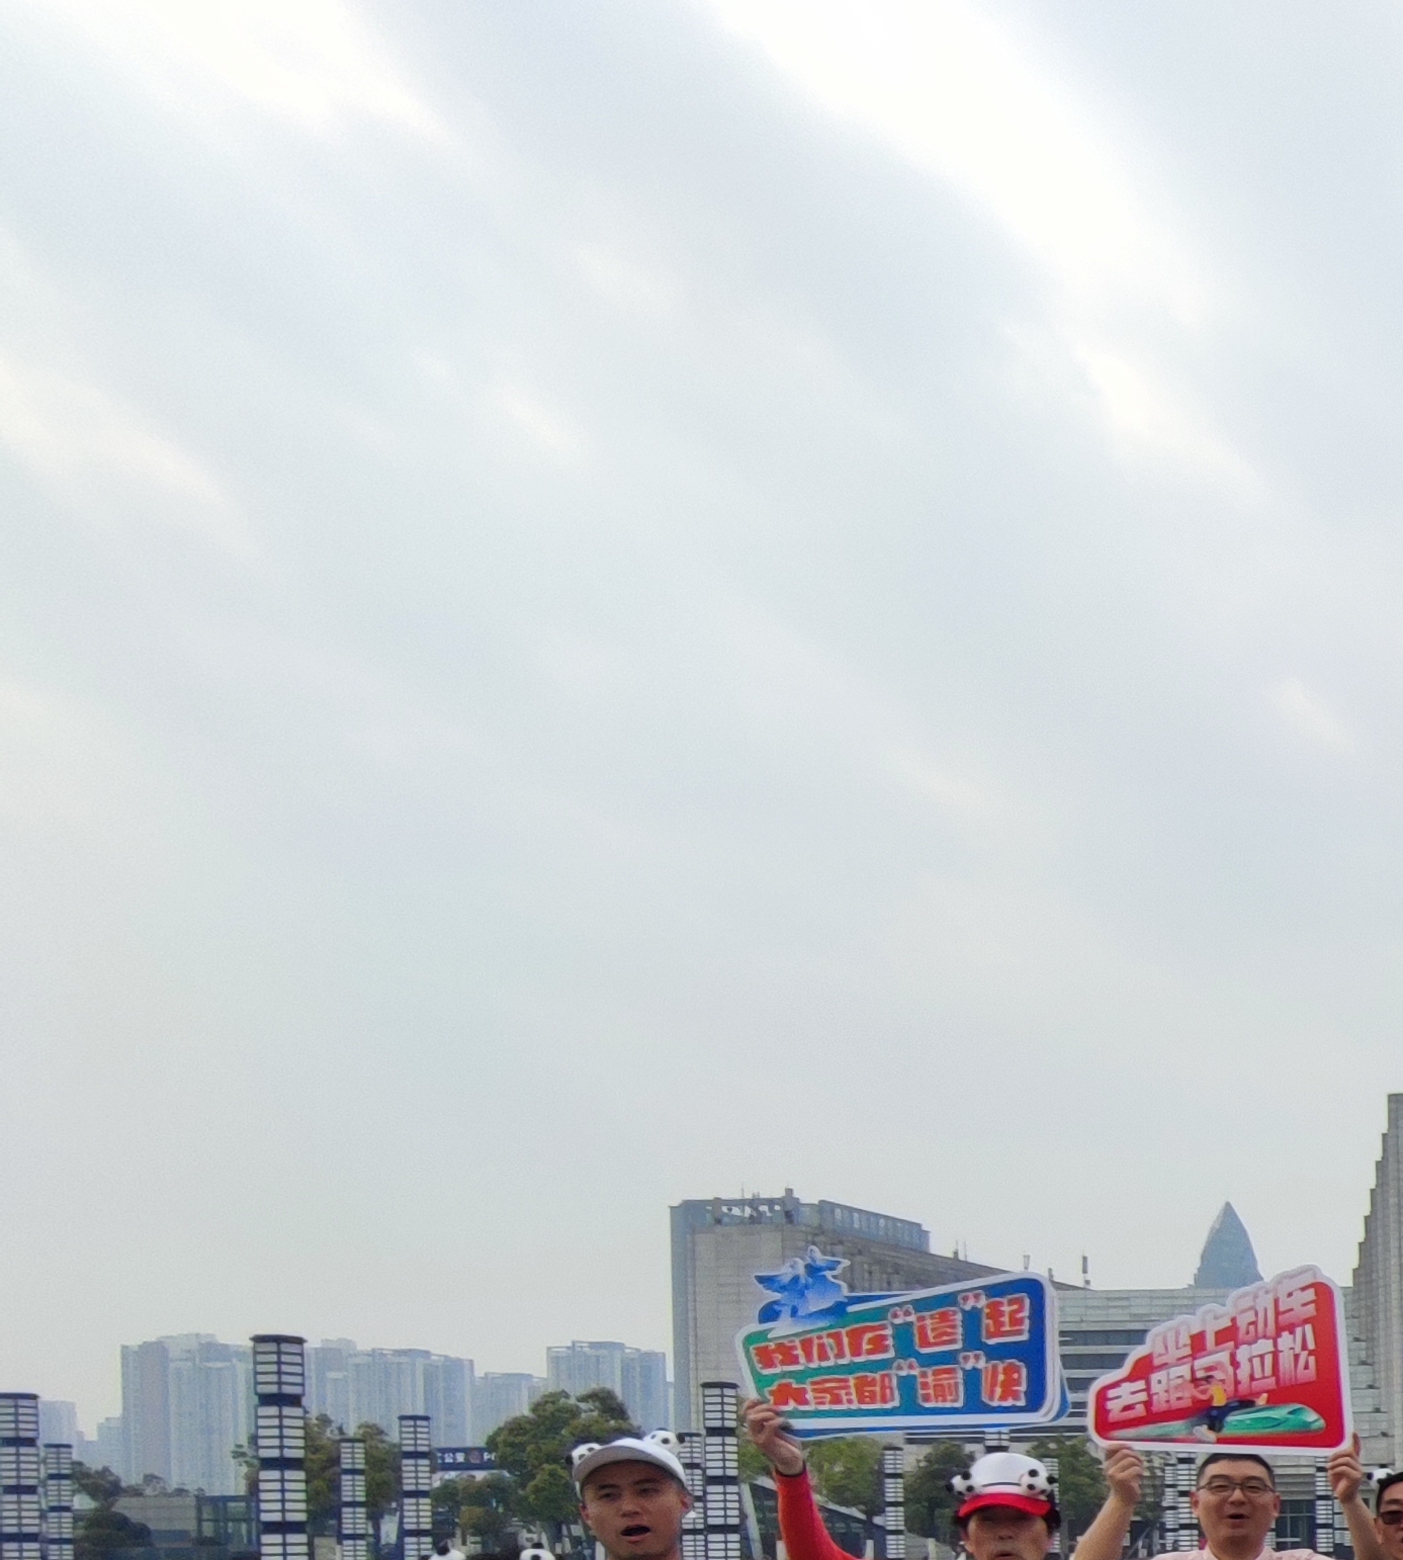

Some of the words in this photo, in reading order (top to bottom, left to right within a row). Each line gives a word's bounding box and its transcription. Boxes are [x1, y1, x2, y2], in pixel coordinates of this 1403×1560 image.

[1153, 1272, 1318, 1368] 坐上动车
[1106, 1325, 1317, 1422] 去跑马拉松
